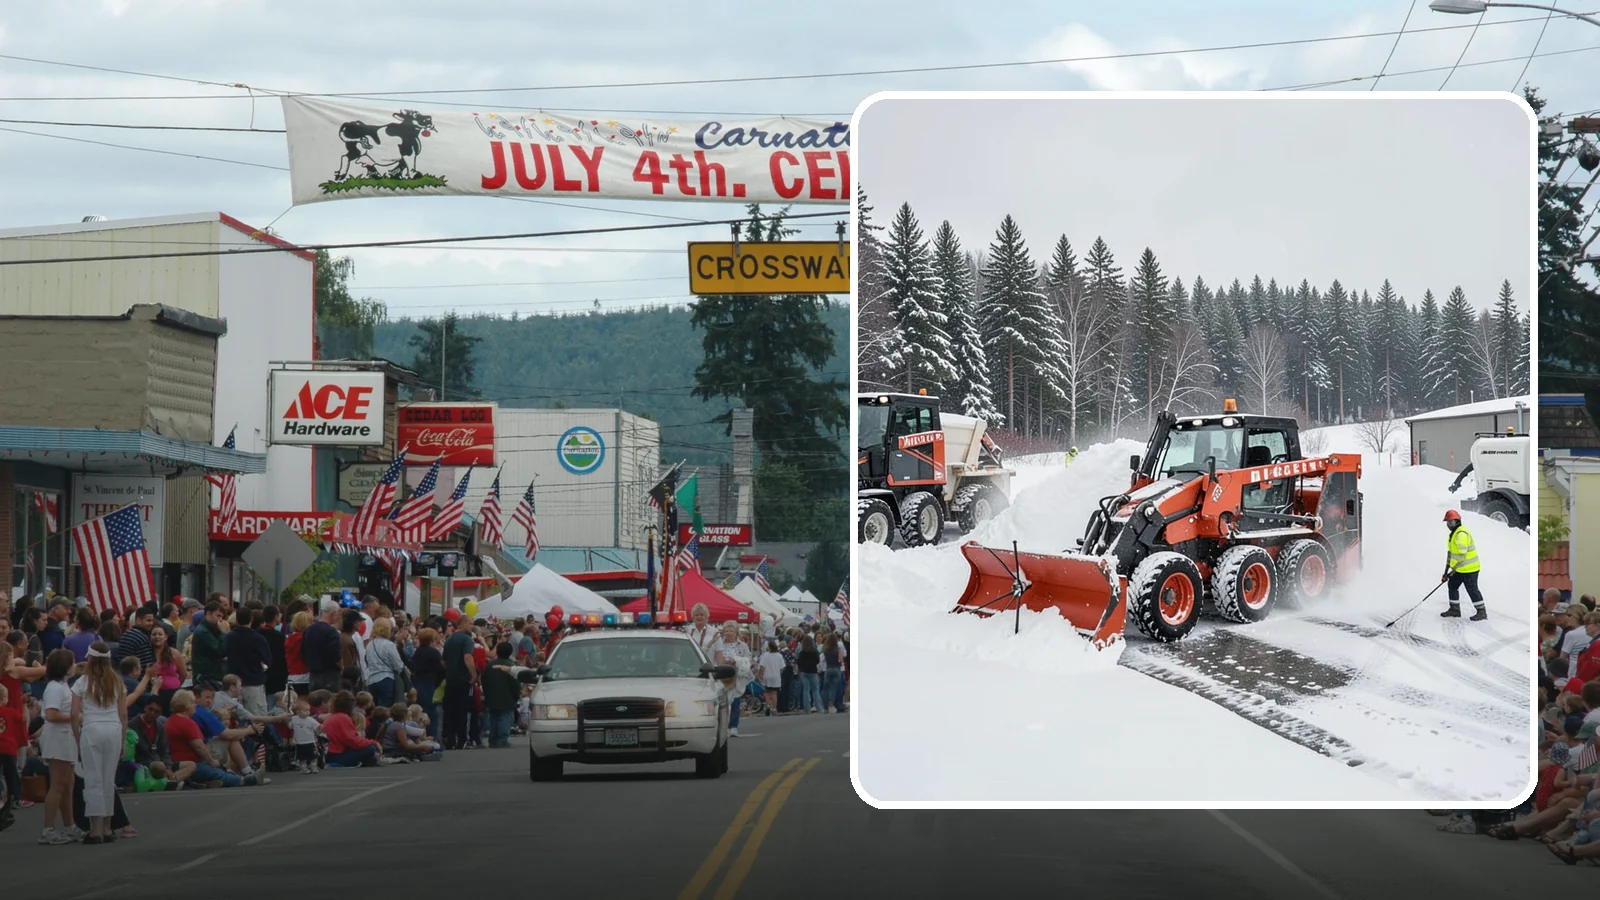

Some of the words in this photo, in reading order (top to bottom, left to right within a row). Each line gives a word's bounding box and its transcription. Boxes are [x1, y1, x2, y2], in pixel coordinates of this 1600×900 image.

[695, 122, 850, 149] Carnat
[481, 141, 604, 192] JULY
[632, 149, 746, 198] 4th.
[697, 253, 850, 280] CROSSWA
[283, 380, 373, 420] ACE
[405, 409, 452, 422] CEDAR
[283, 421, 370, 436] Hardware
[416, 428, 477, 447] Coca-Cola
[354, 467, 387, 481] Simpl
[96, 485, 124, 494] Vincent
[126, 486, 136, 495] de
[138, 486, 155, 495] Paul
[688, 527, 741, 535] CRNATION
[699, 535, 730, 543] GLASS
